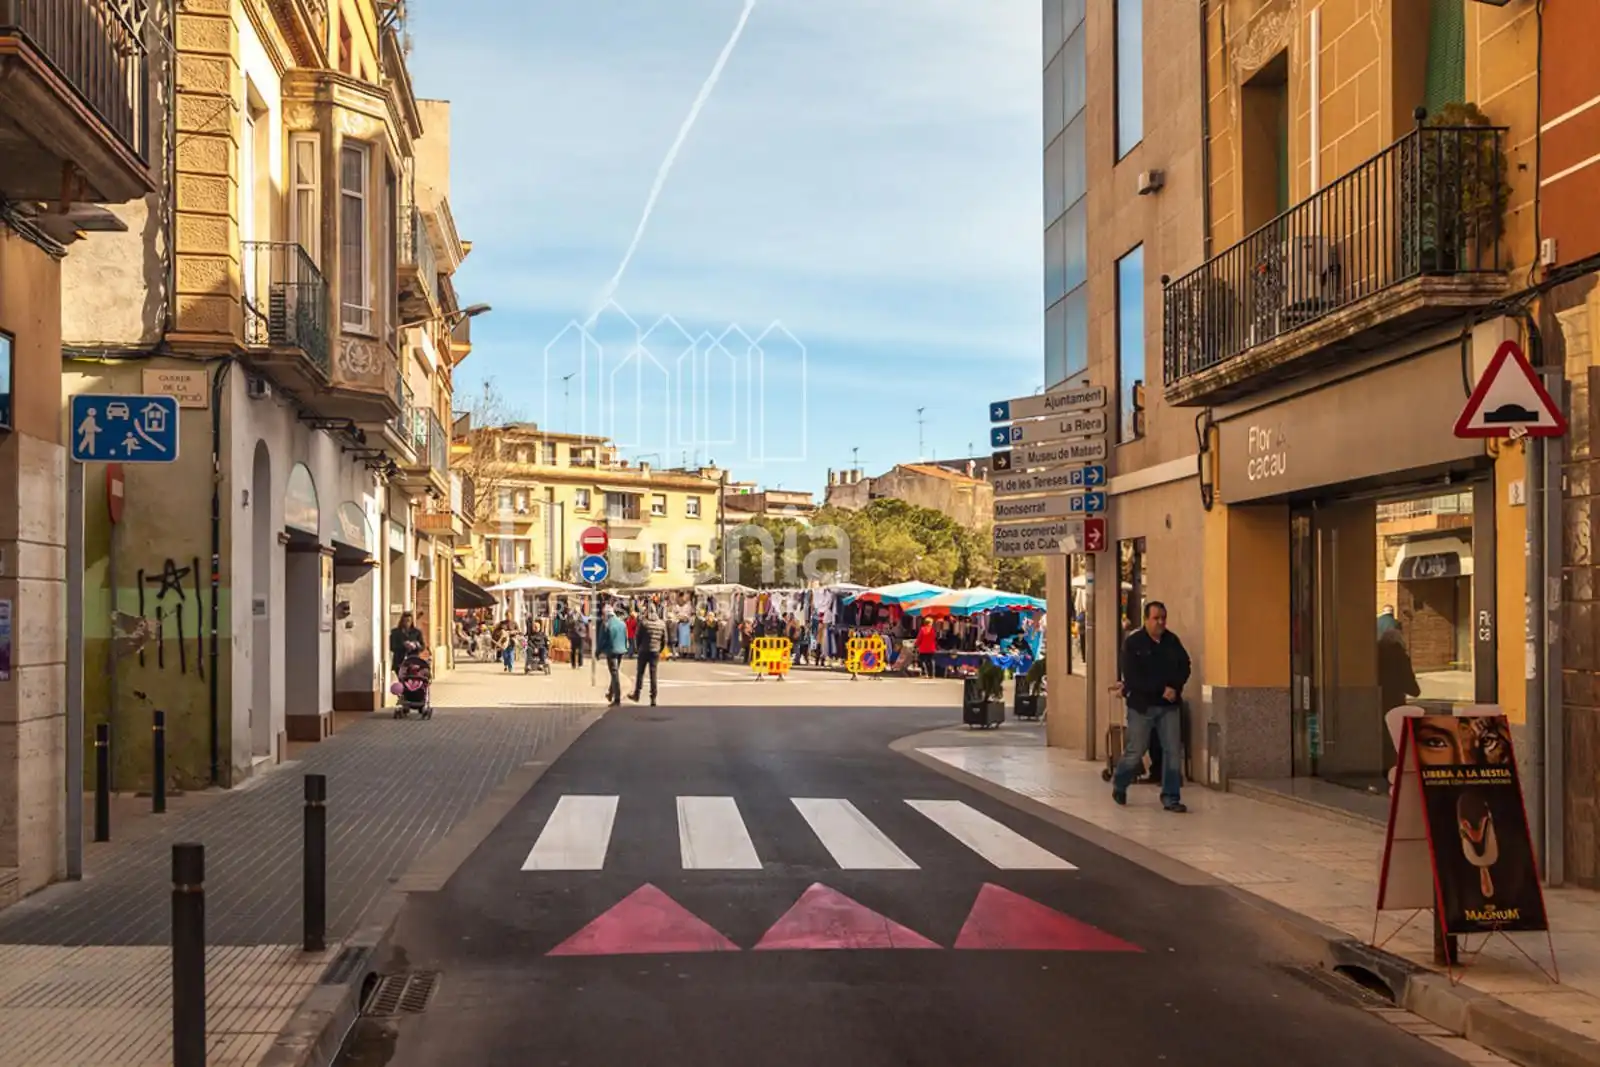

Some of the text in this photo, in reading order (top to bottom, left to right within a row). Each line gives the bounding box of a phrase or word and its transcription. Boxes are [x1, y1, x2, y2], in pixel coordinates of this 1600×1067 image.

[1044, 389, 1102, 410] Ajuntament
[1060, 422, 1072, 433] La
[1074, 418, 1102, 431] Riera
[1248, 426, 1272, 454] Flor
[1028, 451, 1057, 463] Museu
[1058, 448, 1069, 459] de
[1248, 452, 1286, 480] cacau
[1018, 478, 1032, 489] les
[1033, 475, 1068, 488] Tereses
[995, 501, 1046, 516] Montserrat
[995, 523, 1068, 539] Zona comercial
[995, 537, 1060, 554] Plaça de Cub
[1423, 769, 1454, 778] LIBERA
[1466, 769, 1477, 777] LA
[1480, 768, 1511, 777] BESTIA
[1465, 908, 1520, 921] MAGNUM
